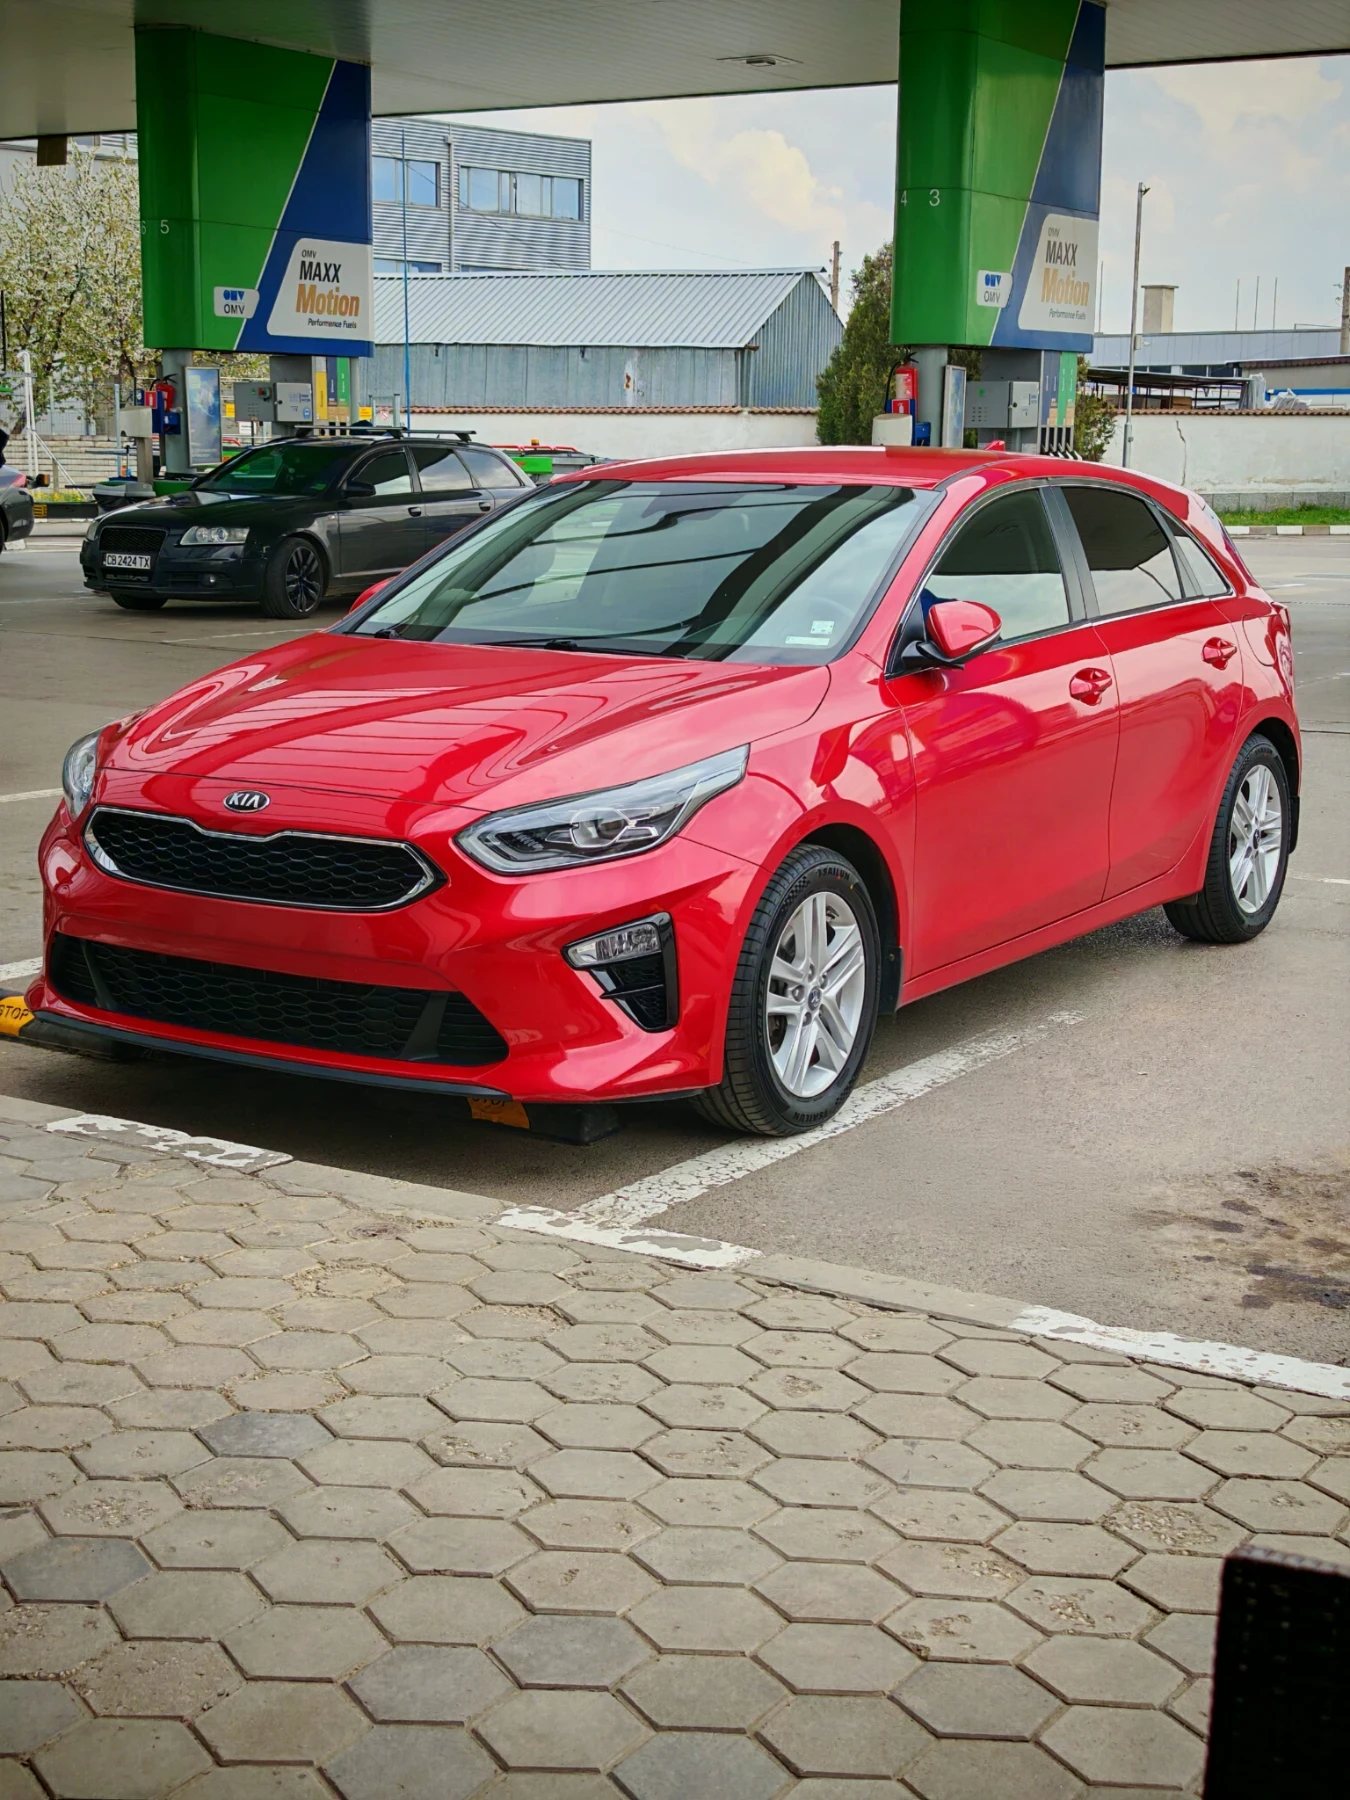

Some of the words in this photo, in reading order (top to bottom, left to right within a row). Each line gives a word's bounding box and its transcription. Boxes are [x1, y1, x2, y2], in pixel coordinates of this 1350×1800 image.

[900, 190, 907, 207] 4
[929, 189, 940, 206] 3
[160, 219, 170, 235] 5
[301, 249, 317, 259] OMV
[1045, 240, 1078, 266] MAXX
[299, 260, 341, 283] MAXX
[1041, 267, 1089, 306] Motion
[295, 283, 360, 317] Motion
[983, 290, 1001, 303] OMV
[223, 303, 245, 315] OMV
[307, 317, 342, 328] Performance
[343, 320, 357, 329] Fuels
[117, 555, 138, 567] 2424
[138, 556, 150, 568] TX
[228, 792, 261, 809] KIA
